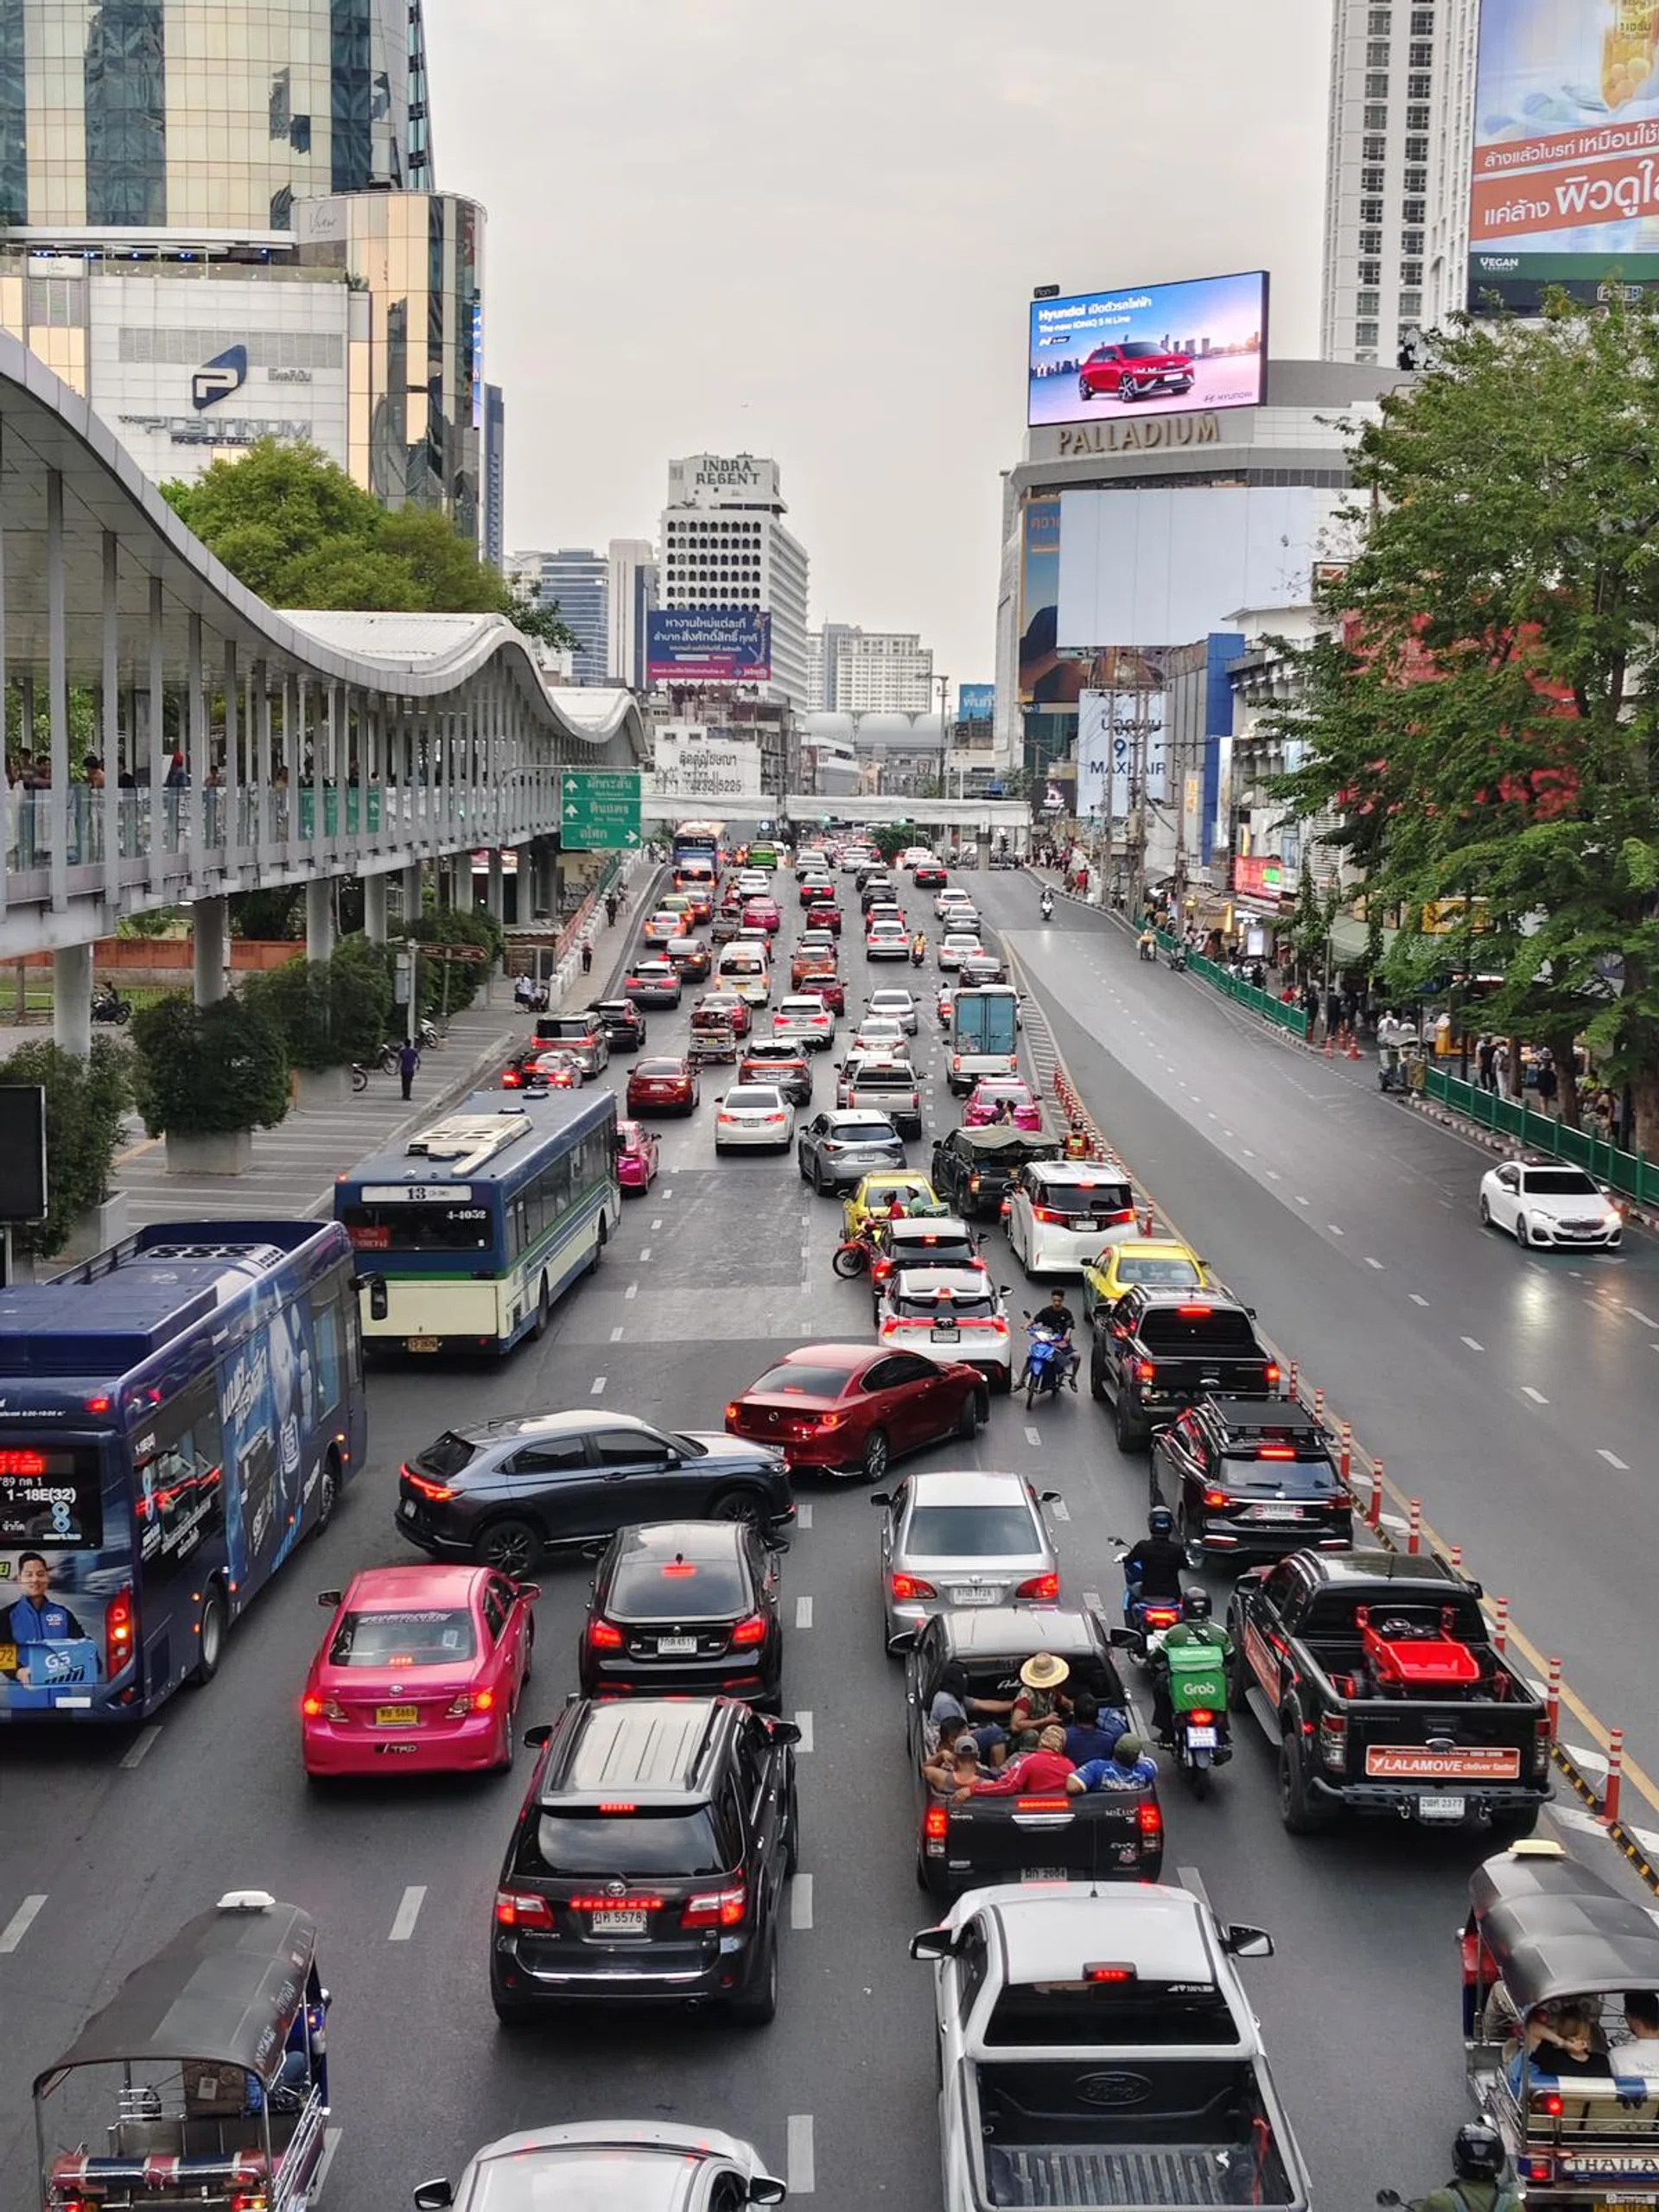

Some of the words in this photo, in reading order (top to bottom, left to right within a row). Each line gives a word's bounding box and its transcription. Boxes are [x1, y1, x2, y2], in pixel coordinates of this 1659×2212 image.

[1579, 124, 1659, 153] เหมือนใช้
[1484, 199, 1550, 226] แค่ล้าง
[1480, 257, 1519, 267] VEGAN
[1039, 305, 1085, 321] Hyundai
[1059, 413, 1219, 455] PALLADIUM
[702, 460, 752, 472] INDRA
[696, 473, 761, 485] REGENT
[407, 1187, 426, 1199] 13
[6, 1487, 77, 1503] 1-18E(32)
[45, 1651, 71, 1669] GS
[1183, 1682, 1217, 1695] Grab
[1383, 1758, 1463, 1772] LALAMOVE
[1493, 1763, 1516, 1771] faster
[614, 1910, 644, 1923] 5578
